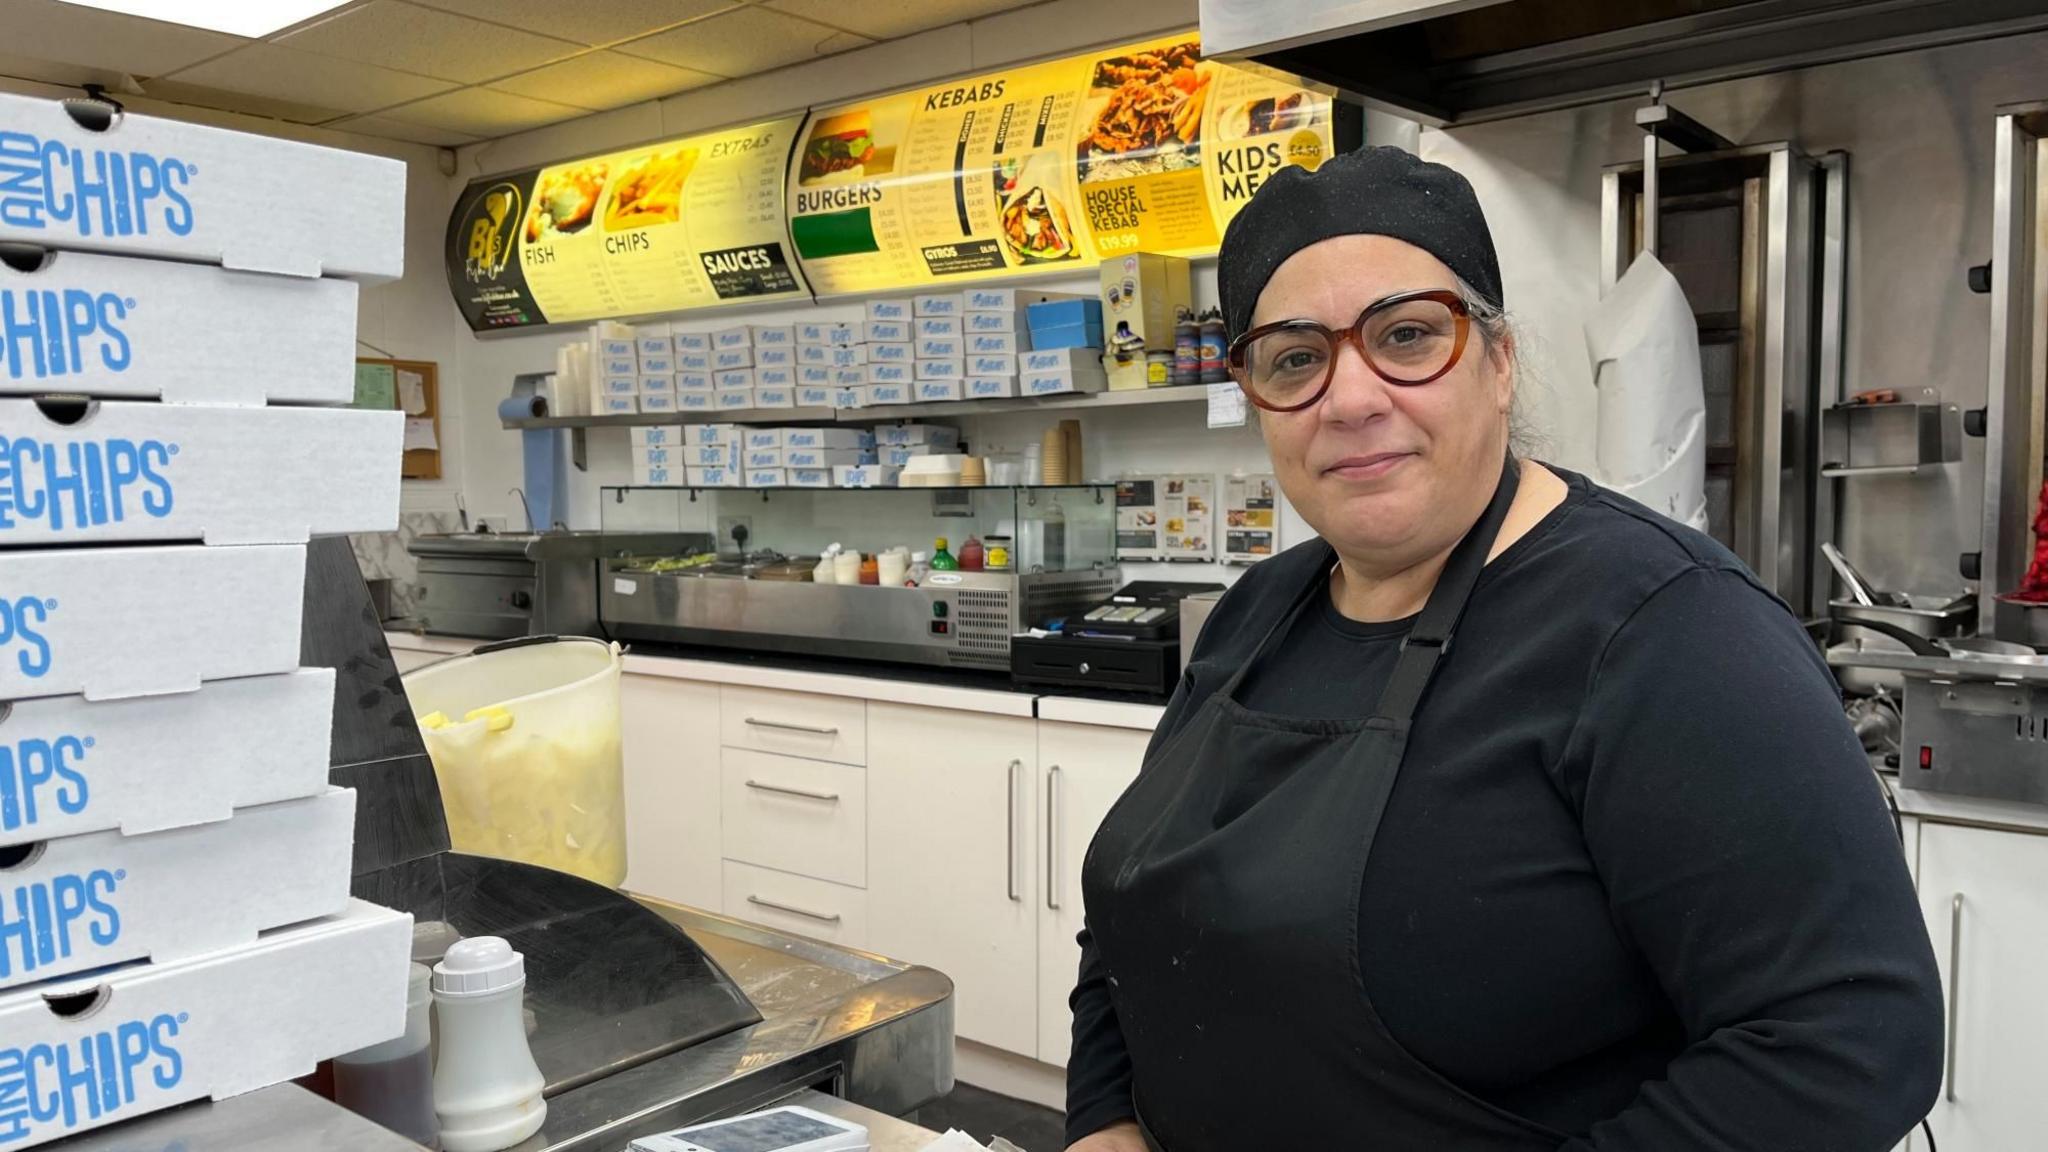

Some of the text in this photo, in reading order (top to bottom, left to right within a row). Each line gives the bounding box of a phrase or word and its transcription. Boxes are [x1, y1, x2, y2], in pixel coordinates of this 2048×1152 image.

[925, 80, 1006, 111] KEBABS
[997, 105, 1013, 144] CHICKEN
[1039, 98, 1053, 125] MIXED
[960, 112, 974, 142] DONER
[710, 133, 774, 158] EXTRAS
[1218, 142, 1281, 175] KIDS
[797, 180, 882, 213] BURGERS
[1086, 185, 1137, 206] HOUSE
[1222, 172, 1270, 200] ME
[1088, 199, 1148, 219] SPECIAL
[1092, 214, 1139, 232] KEBAB
[605, 232, 649, 254] CHIPS
[924, 246, 958, 260] GYROS
[1098, 233, 1139, 250] £19.99
[525, 246, 555, 266] FISH
[703, 248, 772, 275] SAUCES
